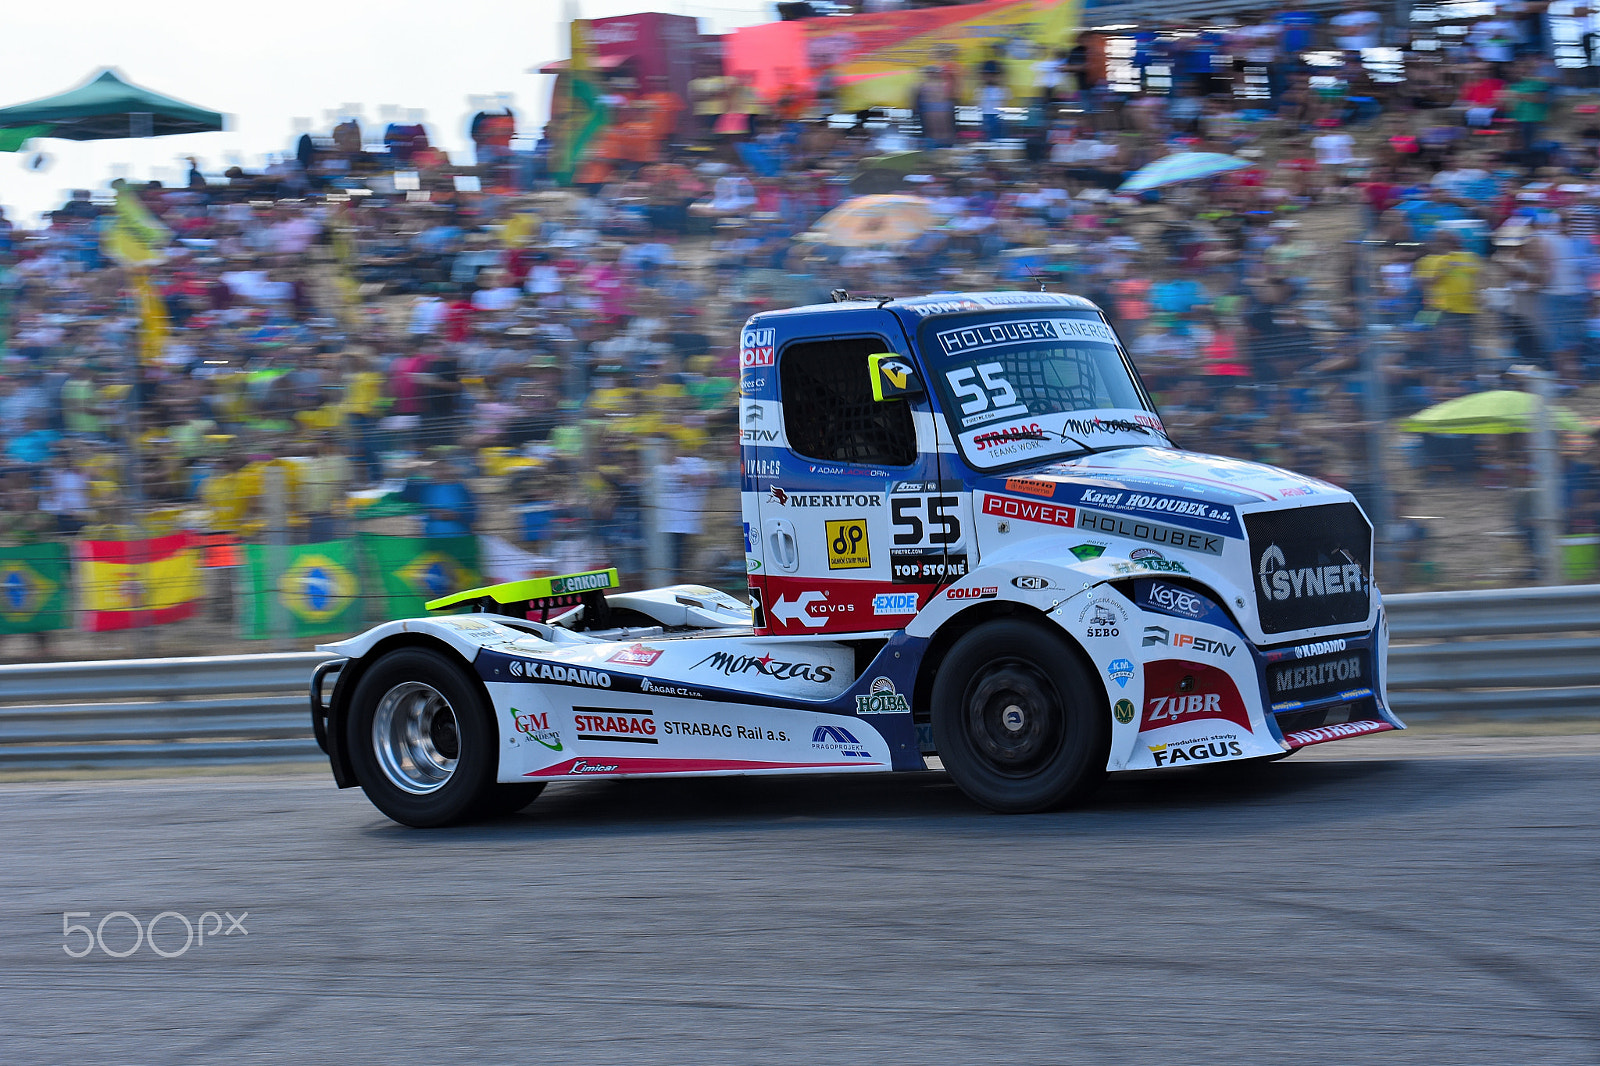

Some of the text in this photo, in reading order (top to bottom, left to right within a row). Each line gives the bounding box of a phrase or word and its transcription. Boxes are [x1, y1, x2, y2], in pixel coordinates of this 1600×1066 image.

[742, 330, 773, 348] QUI
[942, 321, 1112, 351] HOLOUBEK ENERG
[742, 348, 773, 365] OLY
[945, 361, 1017, 416] 55
[988, 446, 1018, 459] TEAMS
[791, 494, 882, 507] MERITOR
[1080, 489, 1232, 521] Karel HOLOUBEK a.s.
[891, 496, 962, 545] 55
[988, 498, 1070, 525] POWER
[1081, 513, 1221, 552] HOLOUBEK
[895, 564, 965, 576] TOP STONE
[1272, 563, 1362, 600] SYNER
[876, 595, 914, 608] EXIDE
[946, 587, 980, 599] GOLD
[811, 604, 855, 613] KOVOS
[1087, 626, 1120, 638] ŠEBO
[1301, 638, 1347, 657] KADAMO
[525, 662, 612, 688] KADAMO
[1112, 660, 1129, 671] KM
[1276, 657, 1361, 692] MERITOR
[677, 688, 688, 696] CZ
[857, 695, 909, 712] HOLBA
[515, 712, 551, 734] GM
[574, 714, 791, 742] STRABAG STRABAG Rail a.s.
[1287, 720, 1381, 743] NUTREND
[811, 743, 864, 751] PRAGOPROJEKT
[1153, 741, 1243, 767] FAGUS
